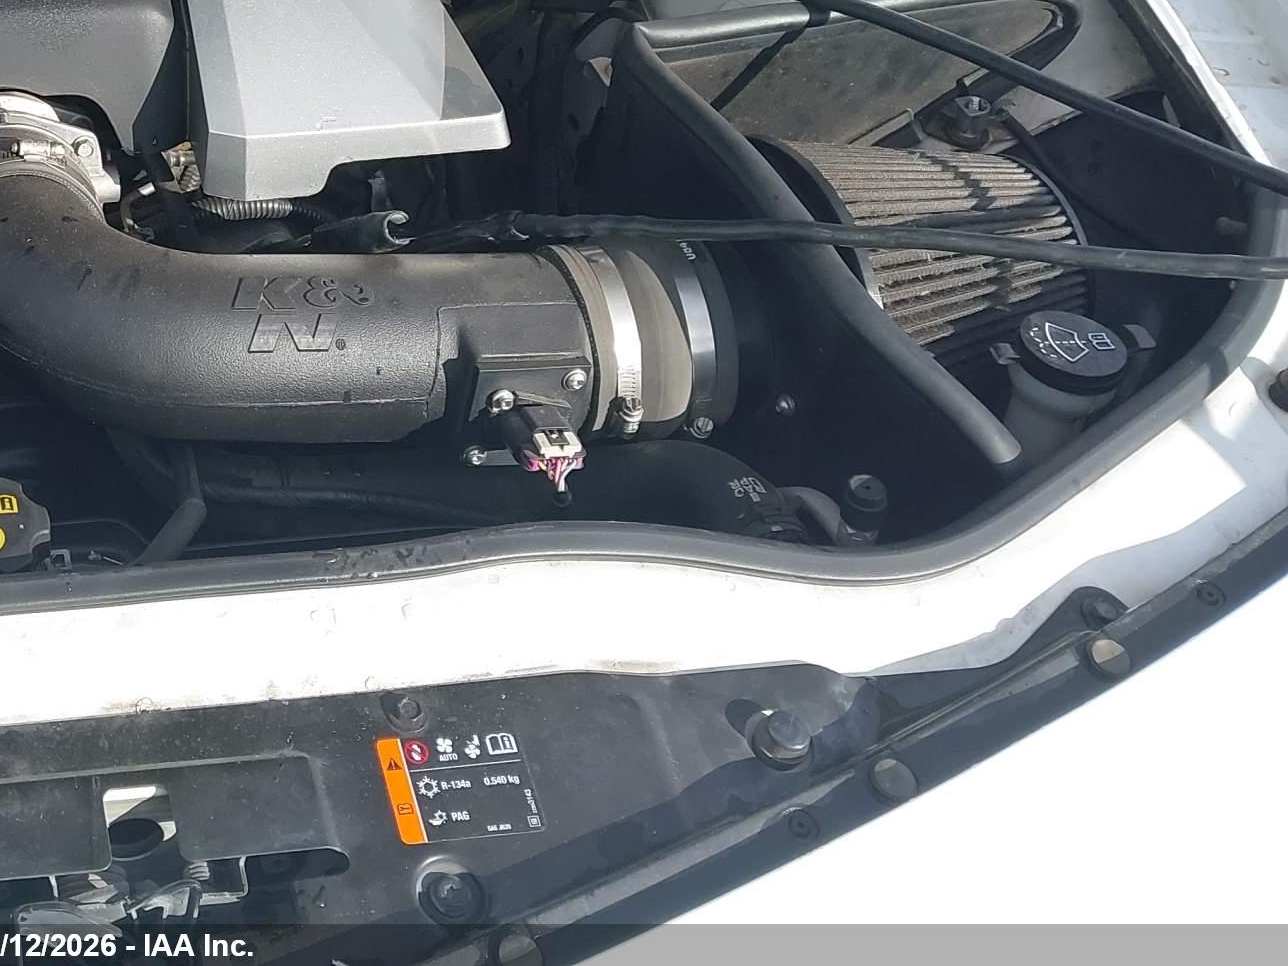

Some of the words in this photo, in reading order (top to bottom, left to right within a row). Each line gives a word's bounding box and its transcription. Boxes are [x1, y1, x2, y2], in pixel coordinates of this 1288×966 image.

[439, 753, 458, 762] AUTO
[441, 780, 471, 790] R-134a
[483, 776, 506, 786] 0.540
[508, 774, 520, 785] kg
[451, 811, 470, 821] PAG
